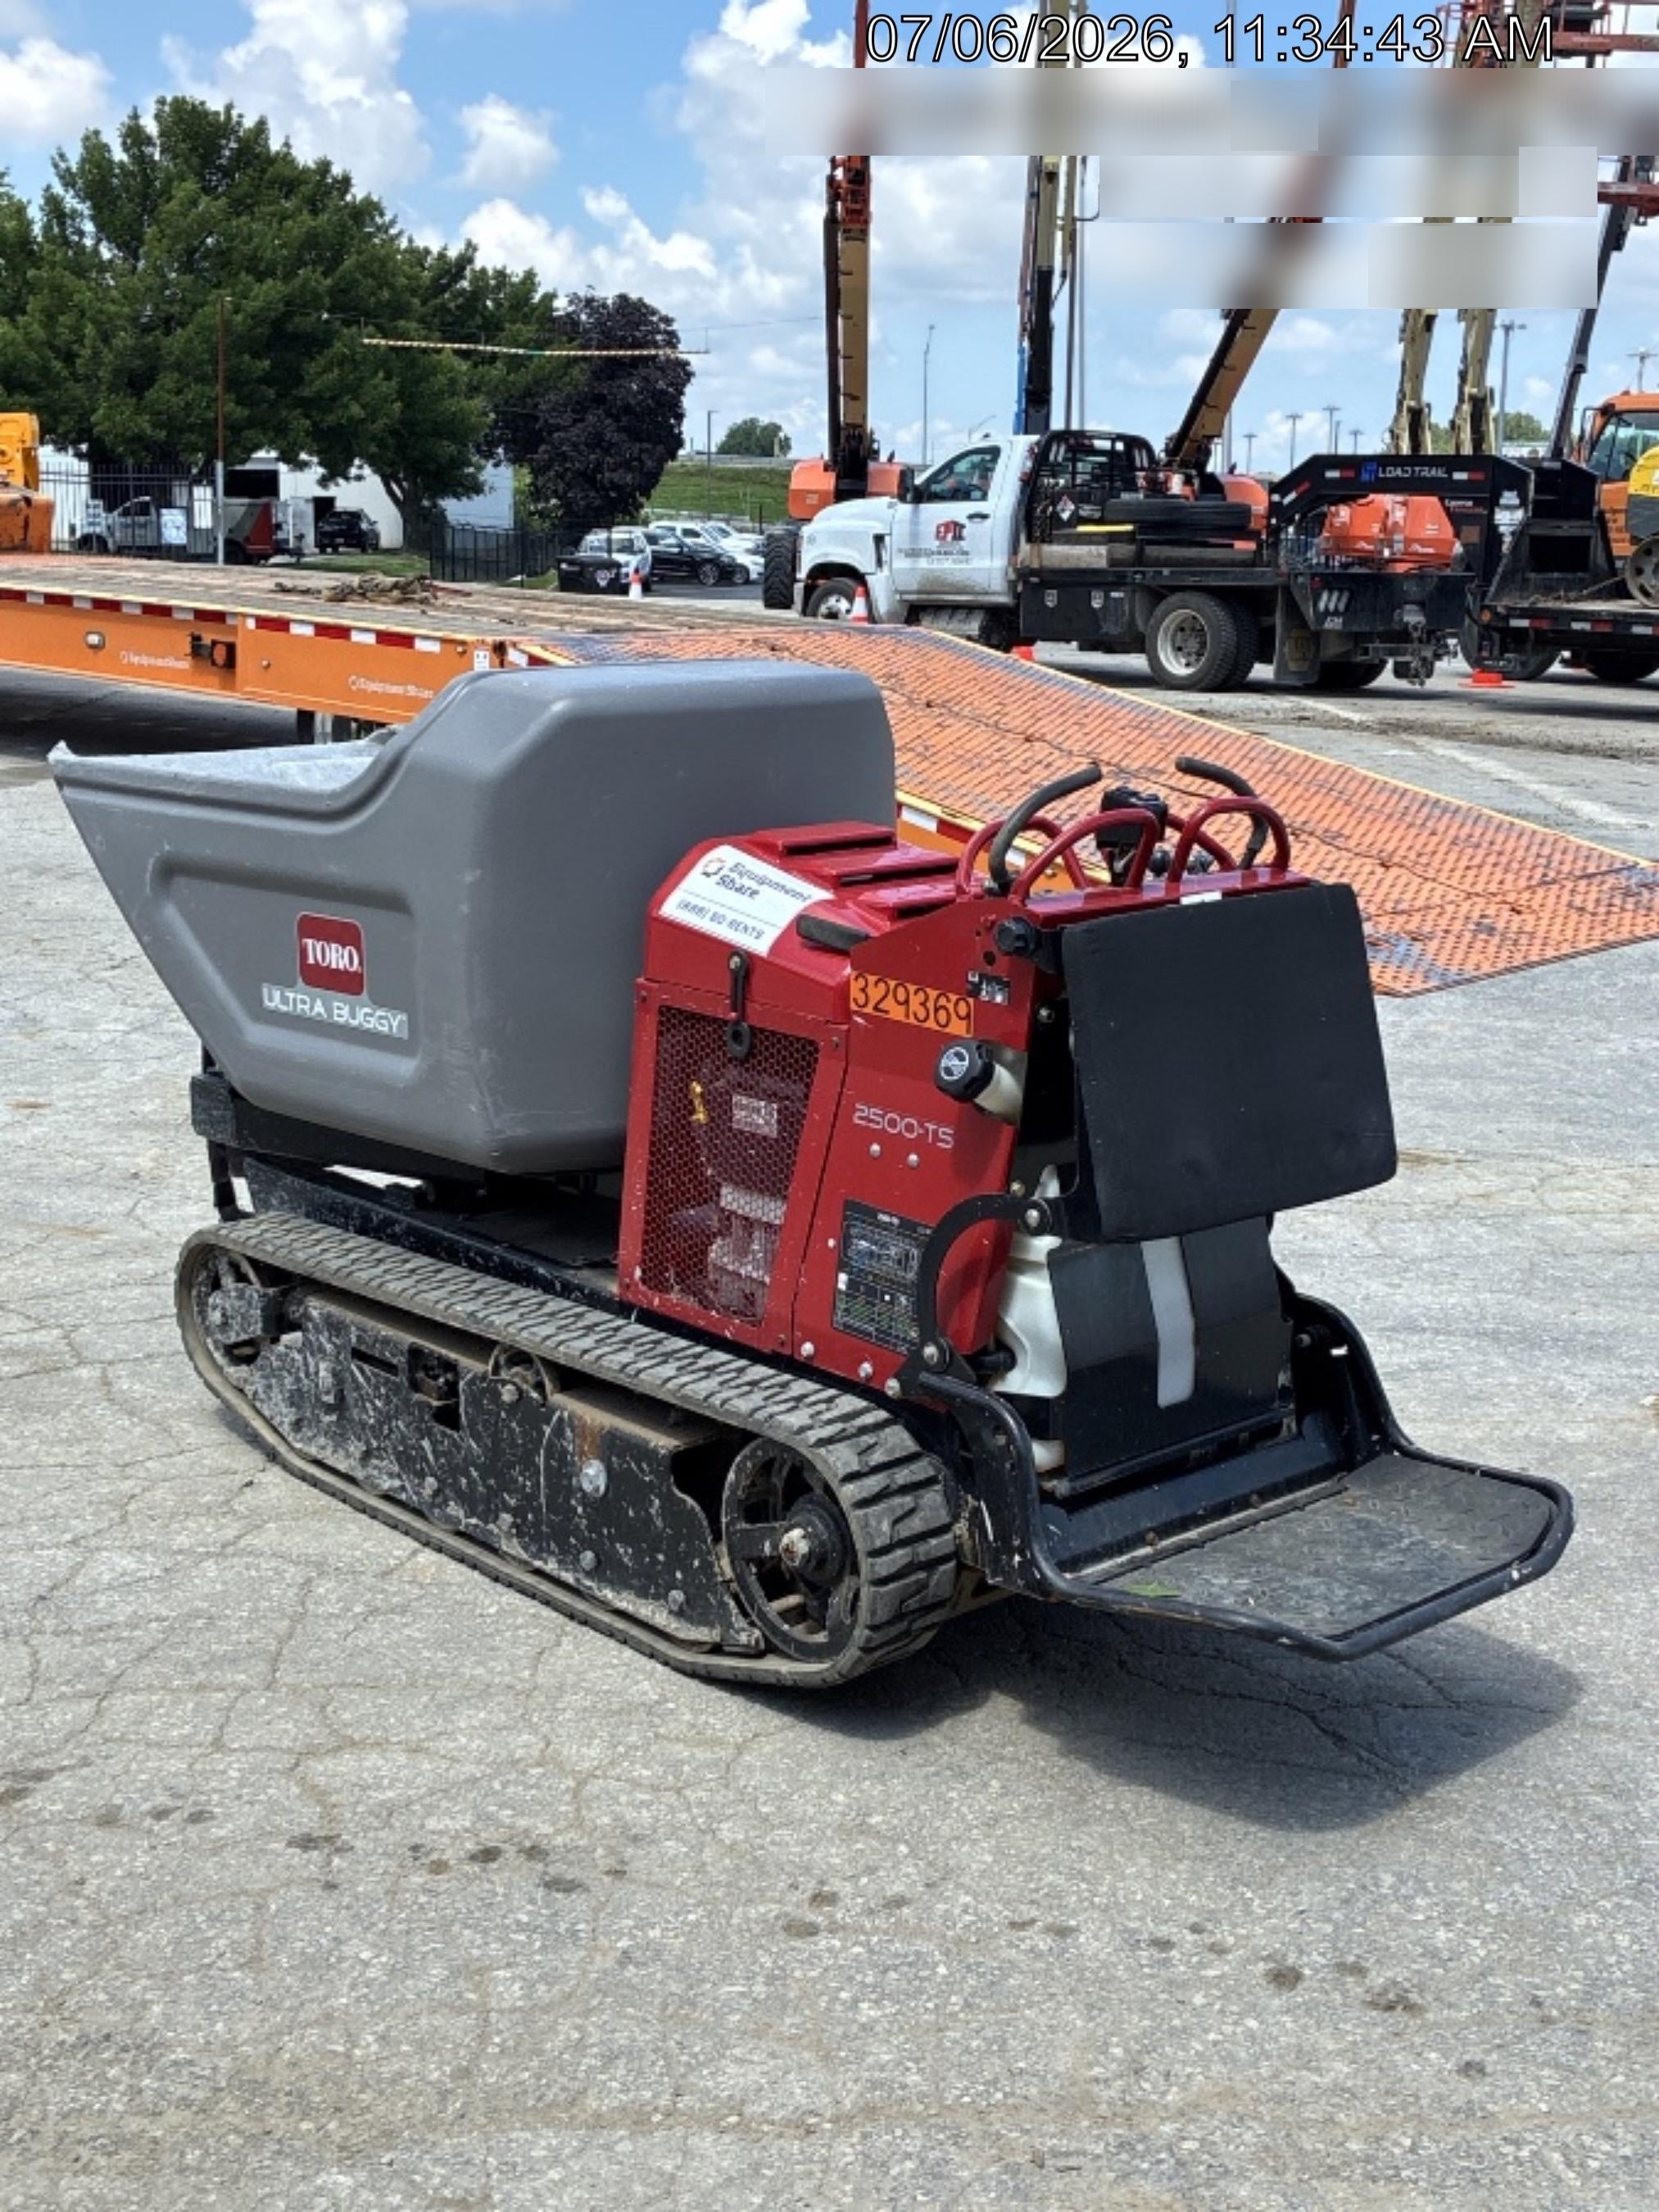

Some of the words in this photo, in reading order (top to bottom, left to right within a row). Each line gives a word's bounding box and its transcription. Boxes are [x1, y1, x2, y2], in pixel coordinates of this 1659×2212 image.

[1378, 466, 1412, 478] LOAD
[715, 873, 761, 900] Share
[728, 861, 813, 903] Equipment
[302, 938, 360, 972] TORO
[262, 985, 328, 1019] ULTRA
[333, 1001, 402, 1035] BUGGY
[853, 973, 972, 1035] 329369
[853, 1103, 954, 1149] 2500-TS
